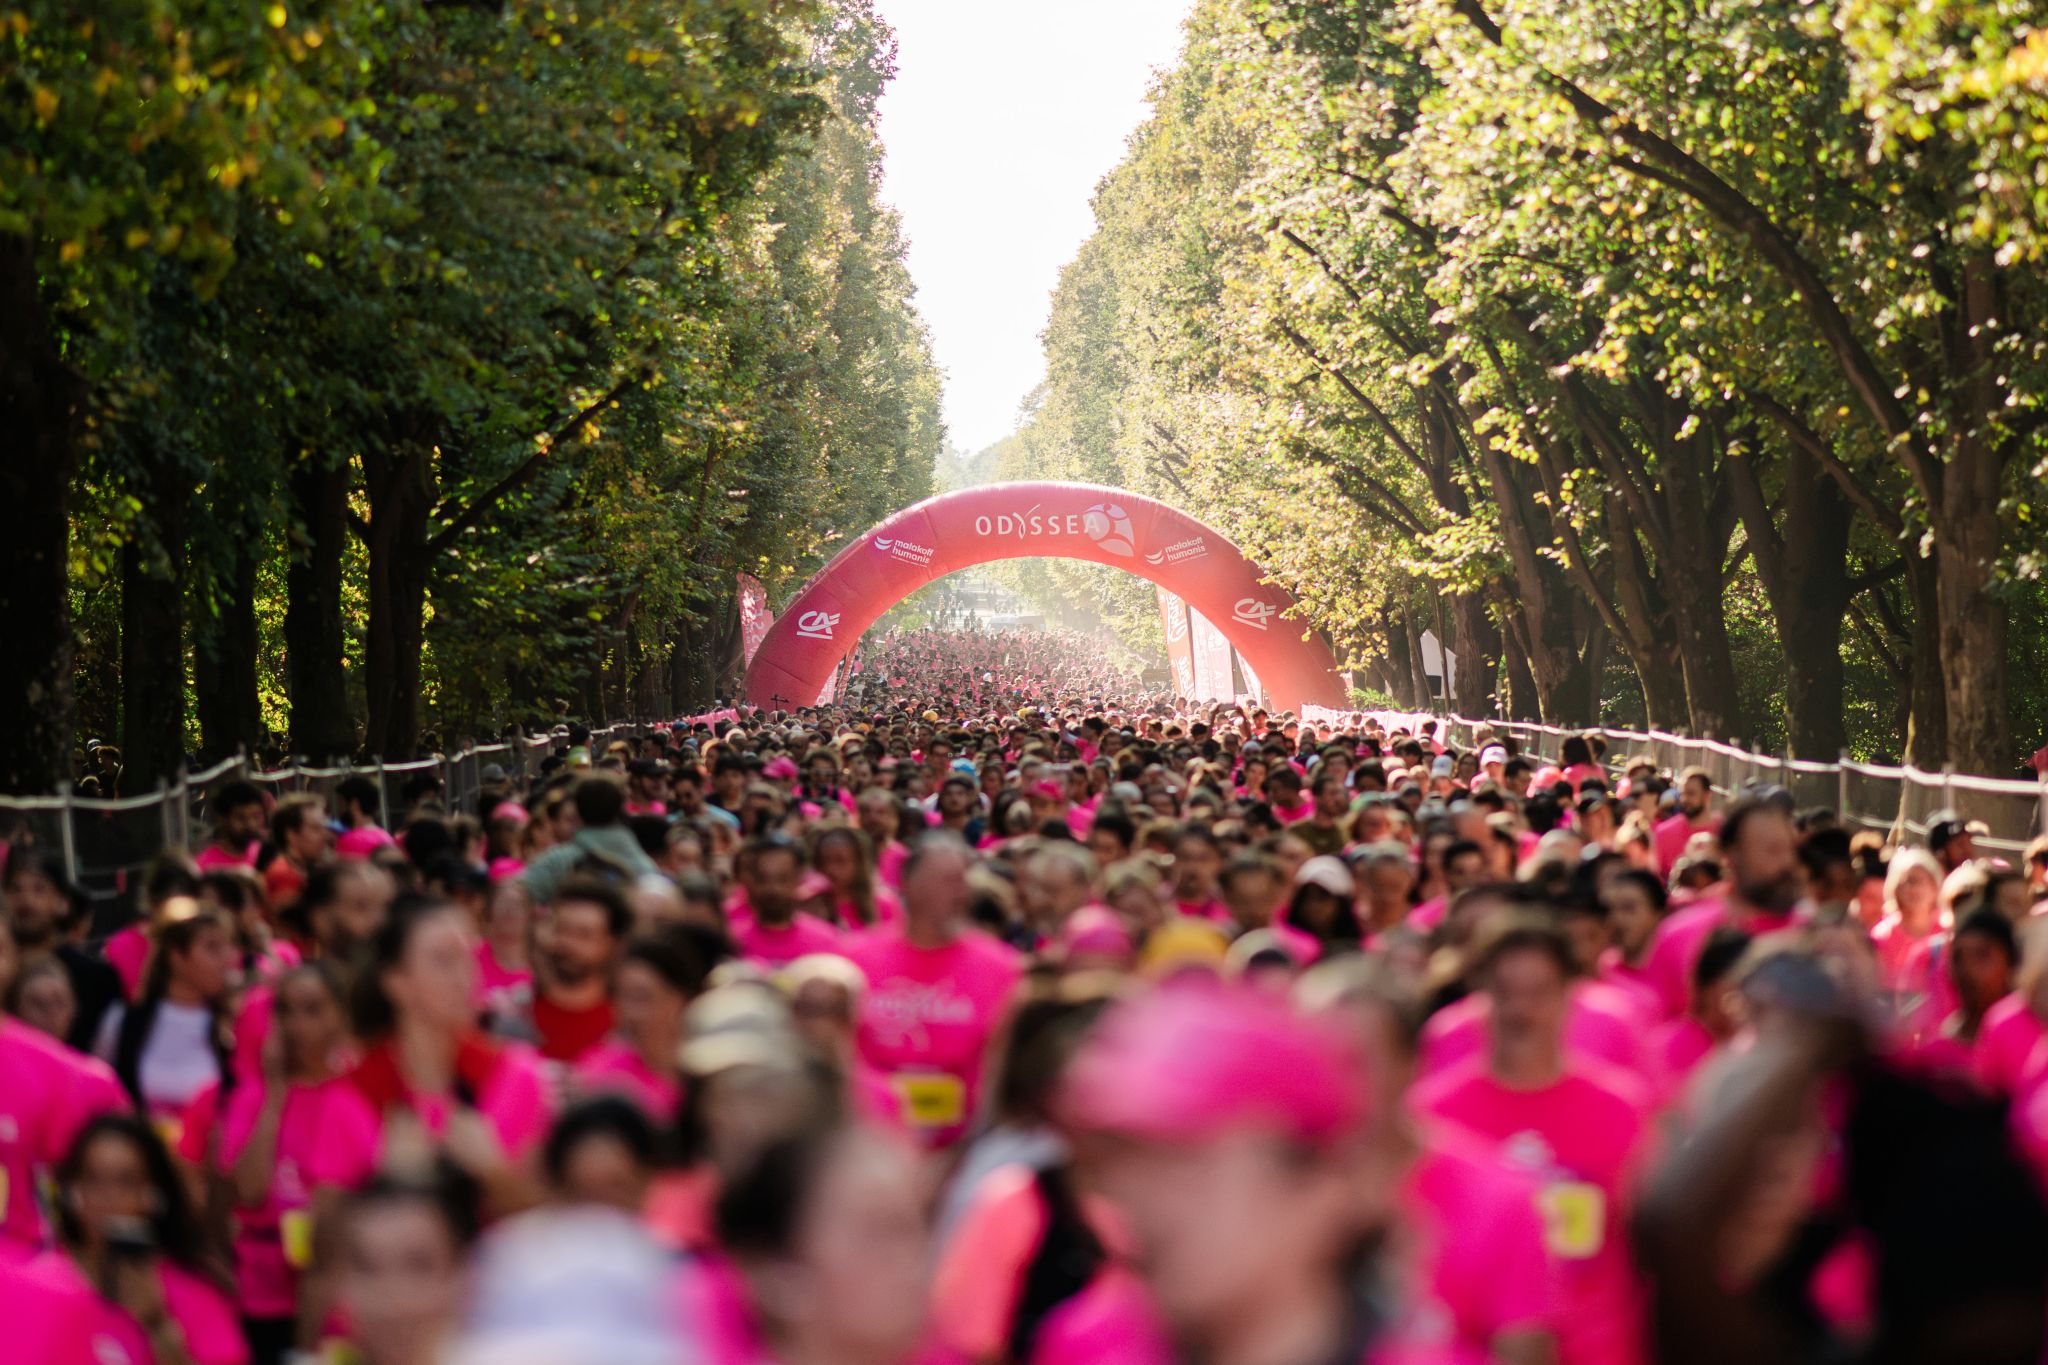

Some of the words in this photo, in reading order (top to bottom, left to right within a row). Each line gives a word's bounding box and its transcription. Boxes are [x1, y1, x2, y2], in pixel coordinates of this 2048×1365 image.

[975, 504, 1101, 539] ODYSSEA
[895, 540, 934, 557] malakoff
[1165, 537, 1203, 553] malakoff
[1167, 545, 1205, 561] humanis
[892, 546, 930, 563] humanis
